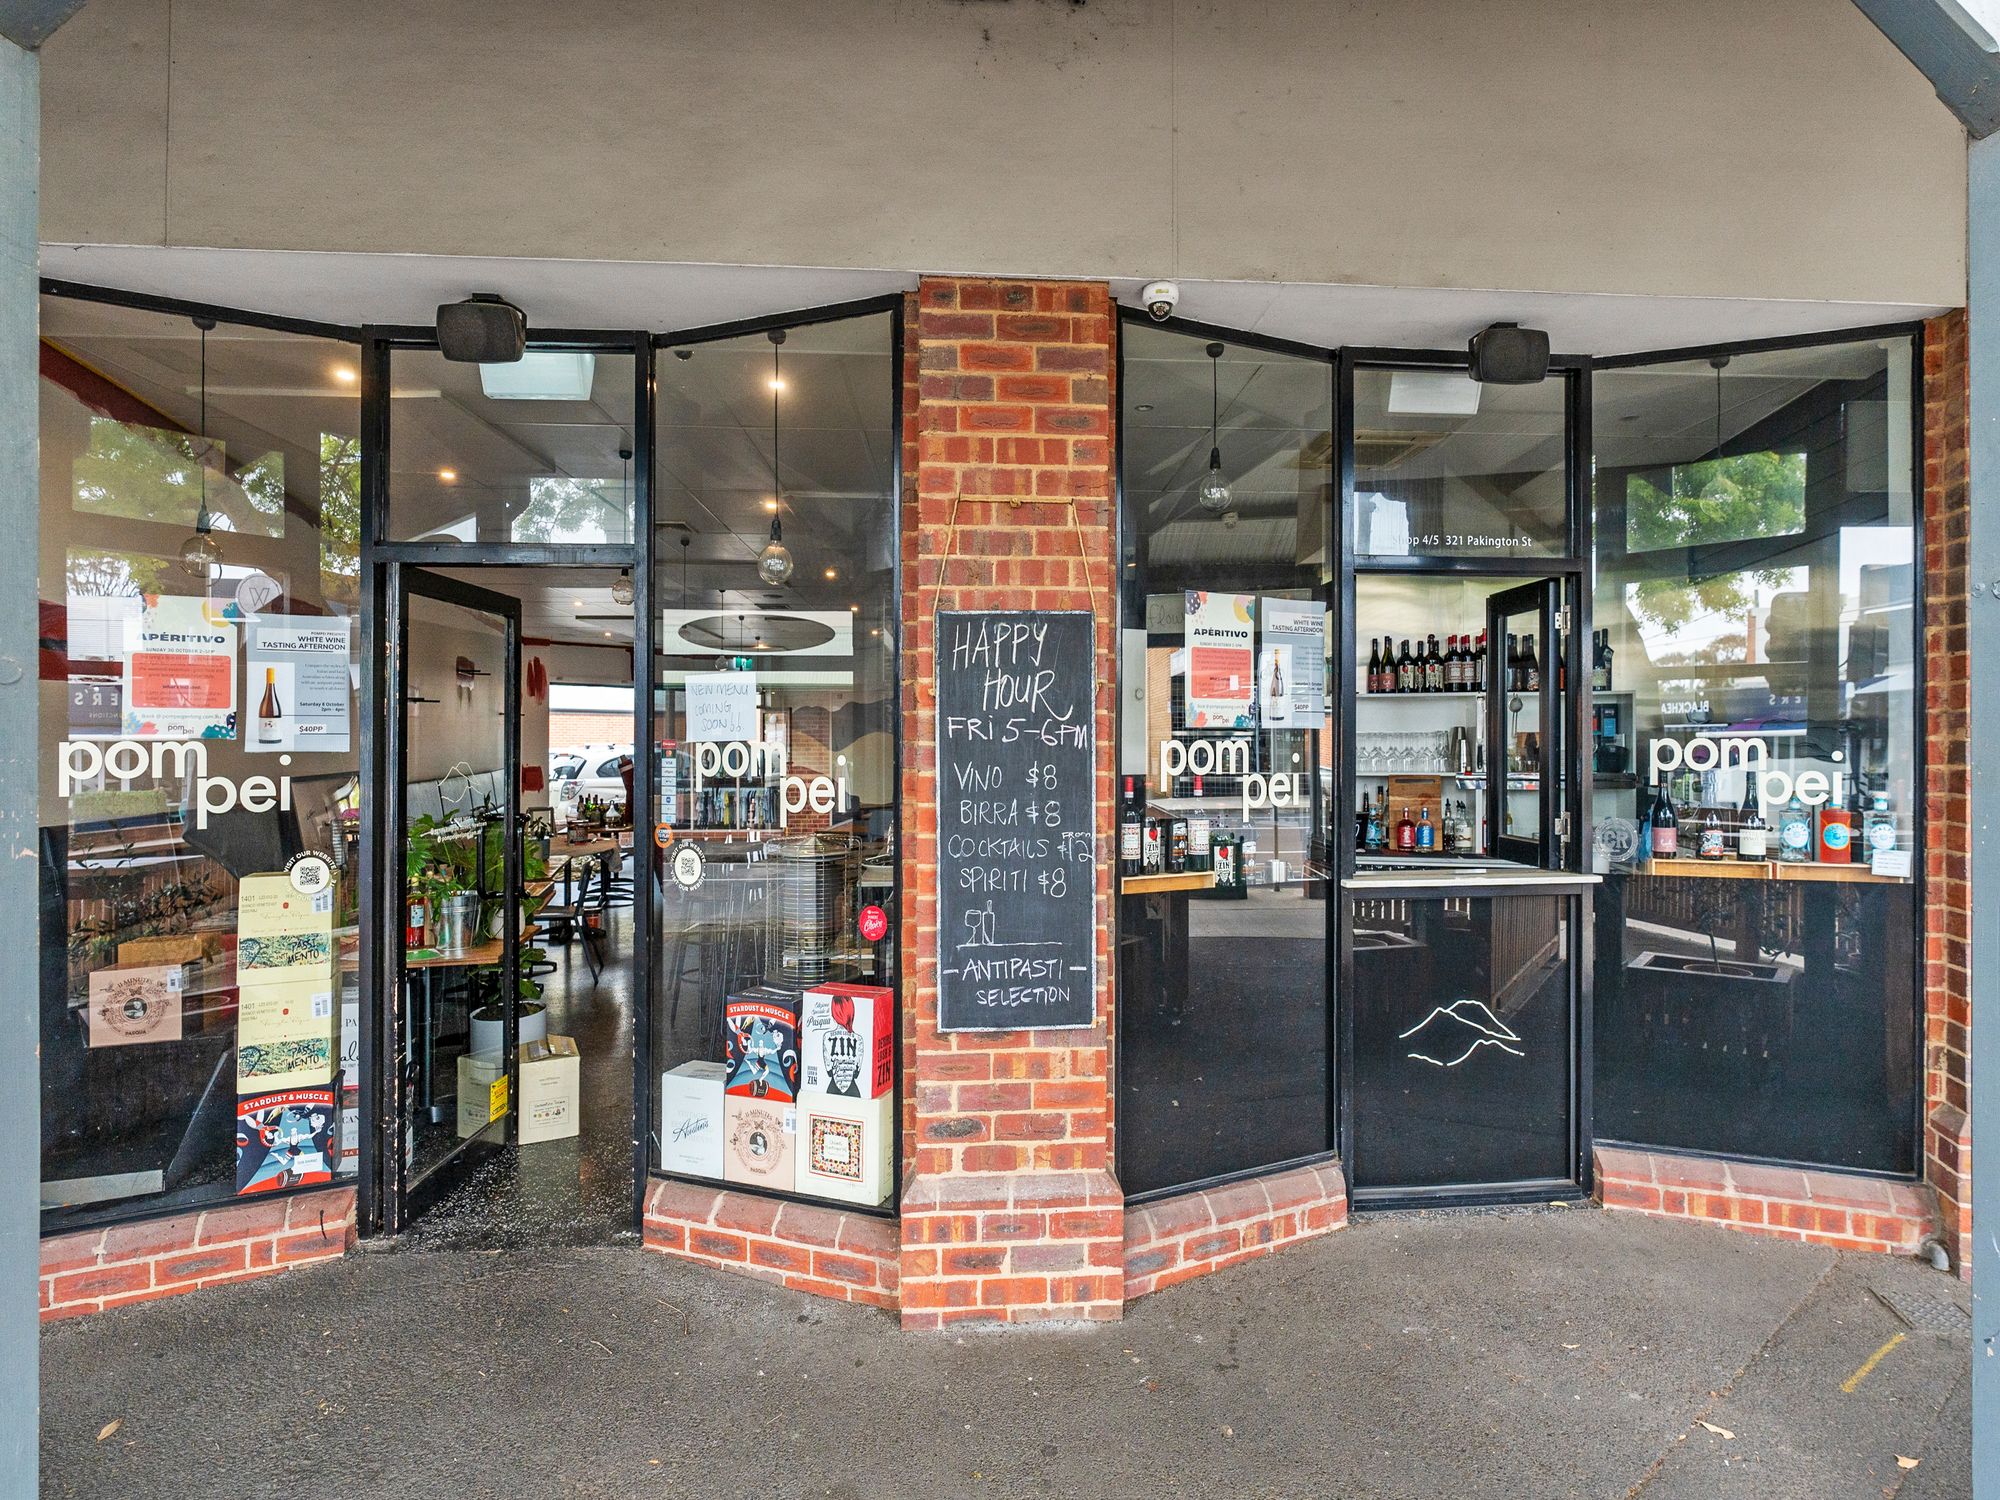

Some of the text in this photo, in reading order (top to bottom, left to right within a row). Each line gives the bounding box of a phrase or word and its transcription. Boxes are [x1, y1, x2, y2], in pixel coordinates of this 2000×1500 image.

[1422, 534, 1439, 546] 4/5
[1445, 535, 1463, 546] 321
[1467, 535, 1519, 549] Pakington
[1521, 536, 1532, 547] St
[1193, 627, 1248, 639] APÉRITIVO
[1272, 624, 1293, 632] TASTING
[262, 641, 297, 649] TASTING
[297, 635, 323, 643] WHITE
[952, 619, 1048, 671] HAPPY
[691, 682, 749, 696] NEW MENU
[983, 668, 1074, 721] HOUR
[299, 725, 324, 733] $40PP
[953, 760, 1058, 793] VINO $8
[960, 798, 1061, 827] BIRRA $8
[947, 834, 1050, 859] COCKTAILS
[283, 850, 338, 873] VISIT OUR WEBSITE
[959, 866, 1067, 898] SPIRITI $8
[287, 948, 320, 965] MENTO
[962, 958, 1064, 983] ANTIPASTI
[975, 986, 1071, 1008] SELECTION
[729, 1005, 760, 1014] STARDUST
[764, 1007, 790, 1020] MUSCLE
[827, 1036, 858, 1058] ZIN
[287, 1054, 320, 1070] MENTO
[807, 1075, 818, 1086] ZIN
[877, 1060, 891, 1088] ZIN
[243, 1094, 287, 1111] STARDUST
[295, 1093, 330, 1101] MUSCLE
